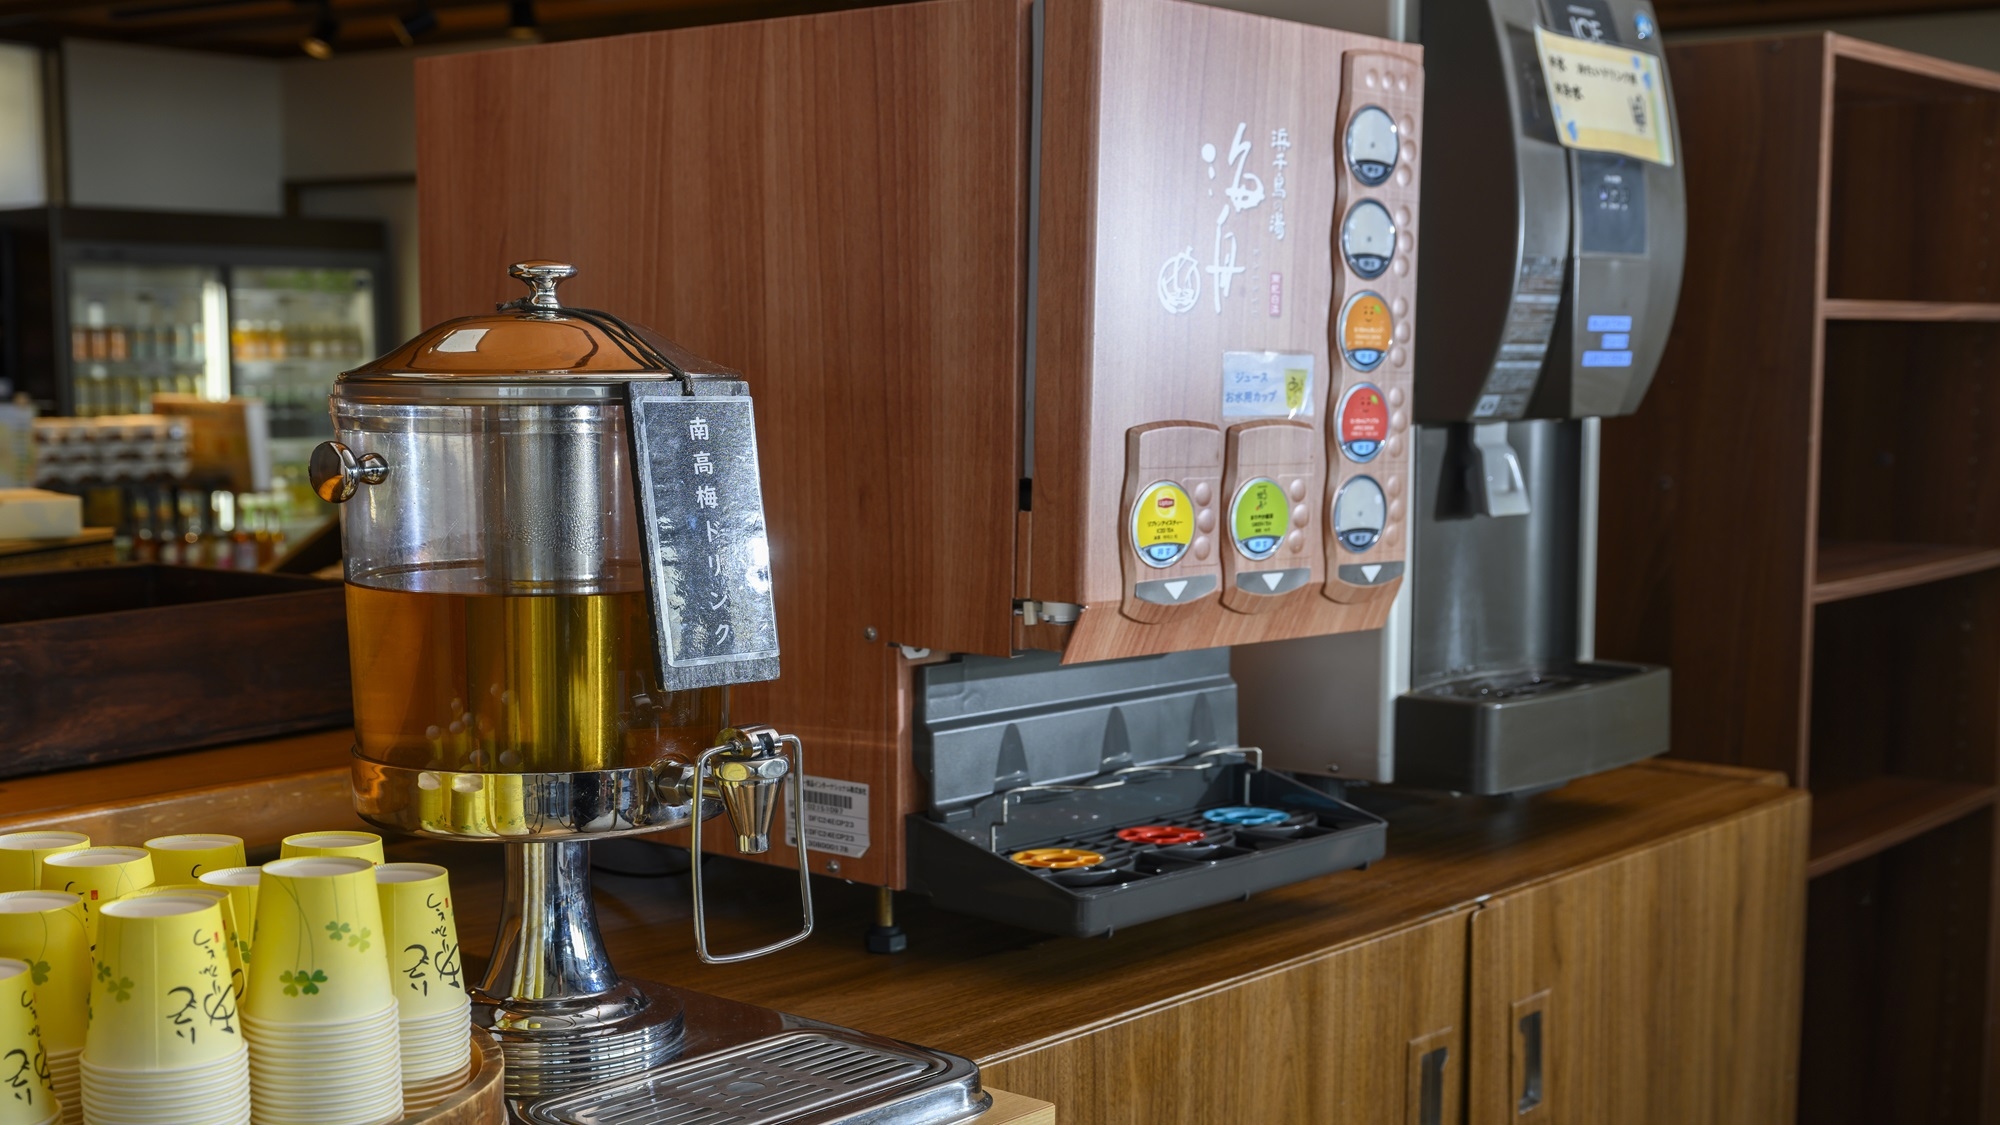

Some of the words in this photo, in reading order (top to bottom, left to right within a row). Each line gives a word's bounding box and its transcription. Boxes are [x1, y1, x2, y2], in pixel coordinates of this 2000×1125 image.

[1569, 16, 1603, 42] ICE
[1268, 128, 1291, 240] 浜千鳥の湯
[1225, 390, 1277, 403] お水用カップ
[1234, 372, 1268, 383] ジュース
[689, 416, 731, 646] 南高梅ドリンク
[193, 928, 236, 1035] ありがとう
[426, 892, 461, 989] ありがとう
